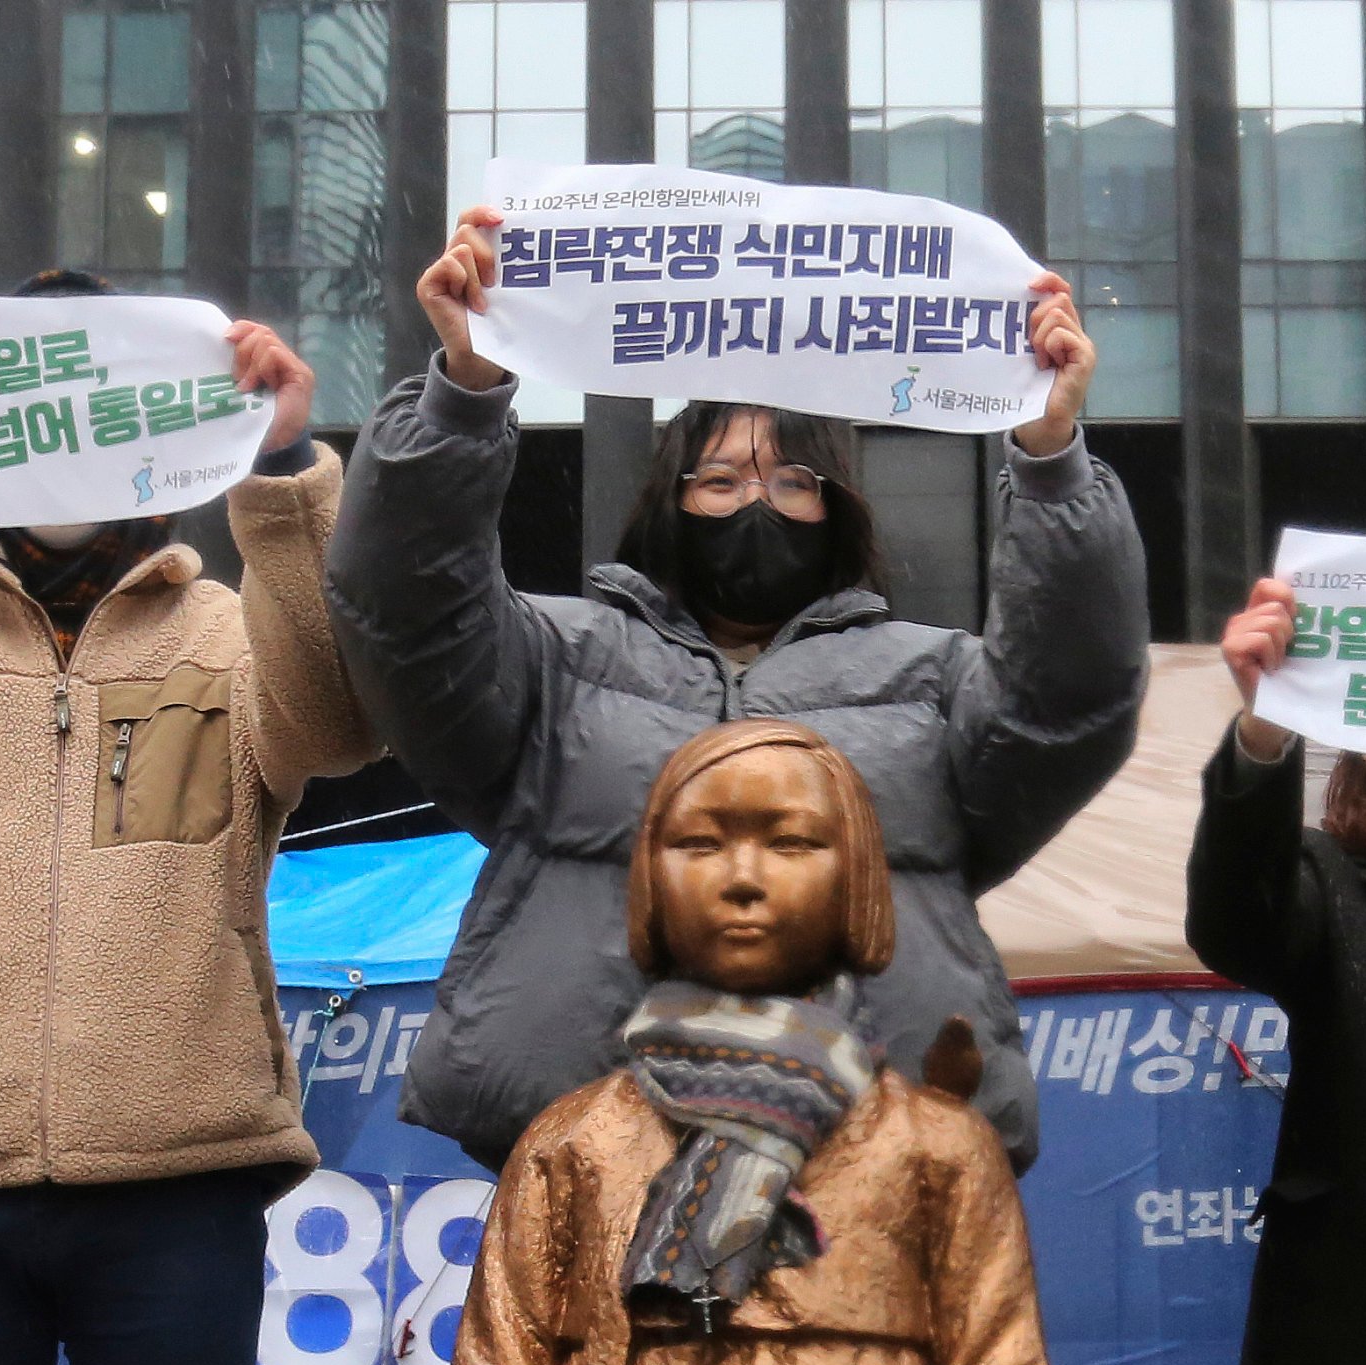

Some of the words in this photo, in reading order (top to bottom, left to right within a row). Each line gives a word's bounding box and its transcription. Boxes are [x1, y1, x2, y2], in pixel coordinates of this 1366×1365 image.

[502, 196, 528, 211] 3.1
[531, 192, 599, 210] 102주년
[602, 189, 761, 209] 온라인항일만세시위
[501, 223, 721, 289] 침략전쟁
[733, 224, 953, 281] 식민지배
[612, 298, 781, 365] 끝까지
[923, 388, 1023, 415] 서울겨레하나
[1290, 571, 1316, 589] 3.1
